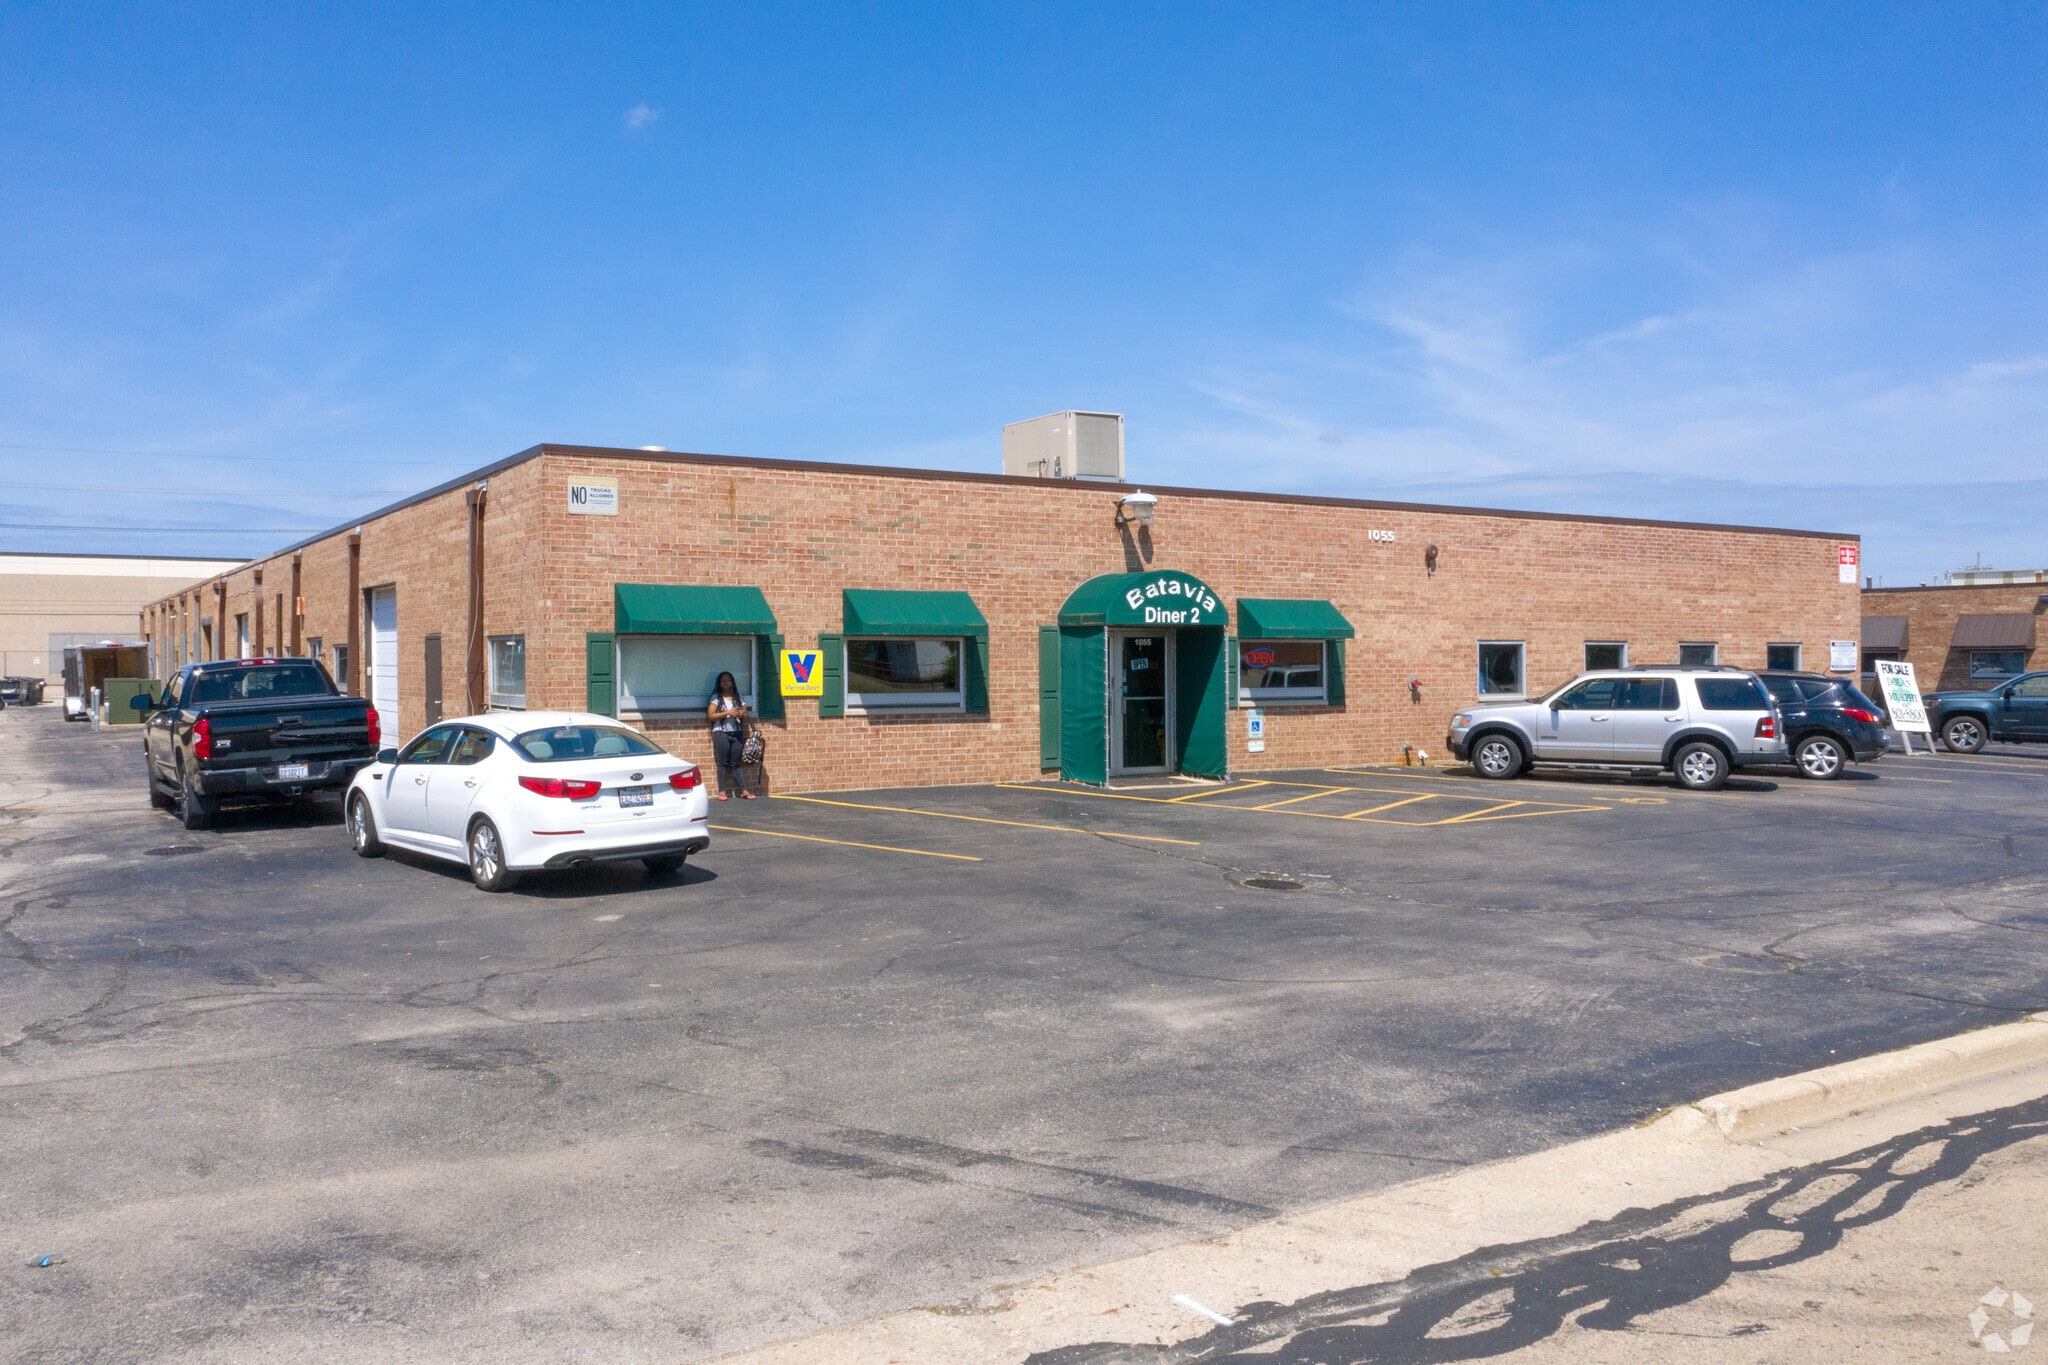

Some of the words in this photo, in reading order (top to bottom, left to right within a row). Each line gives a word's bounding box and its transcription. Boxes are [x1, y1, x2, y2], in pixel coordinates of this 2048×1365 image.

[571, 486, 587, 504] NO
[1368, 529, 1395, 541] 1055
[1126, 578, 1216, 613] Batavia
[1145, 606, 1187, 623] Diner
[1190, 607, 1200, 623] 2
[1134, 638, 1152, 646] 1055
[1246, 651, 1275, 664] OPEN
[1132, 660, 1147, 669] OPEN
[1881, 663, 1894, 674] FOR
[1894, 664, 1910, 676] SALE
